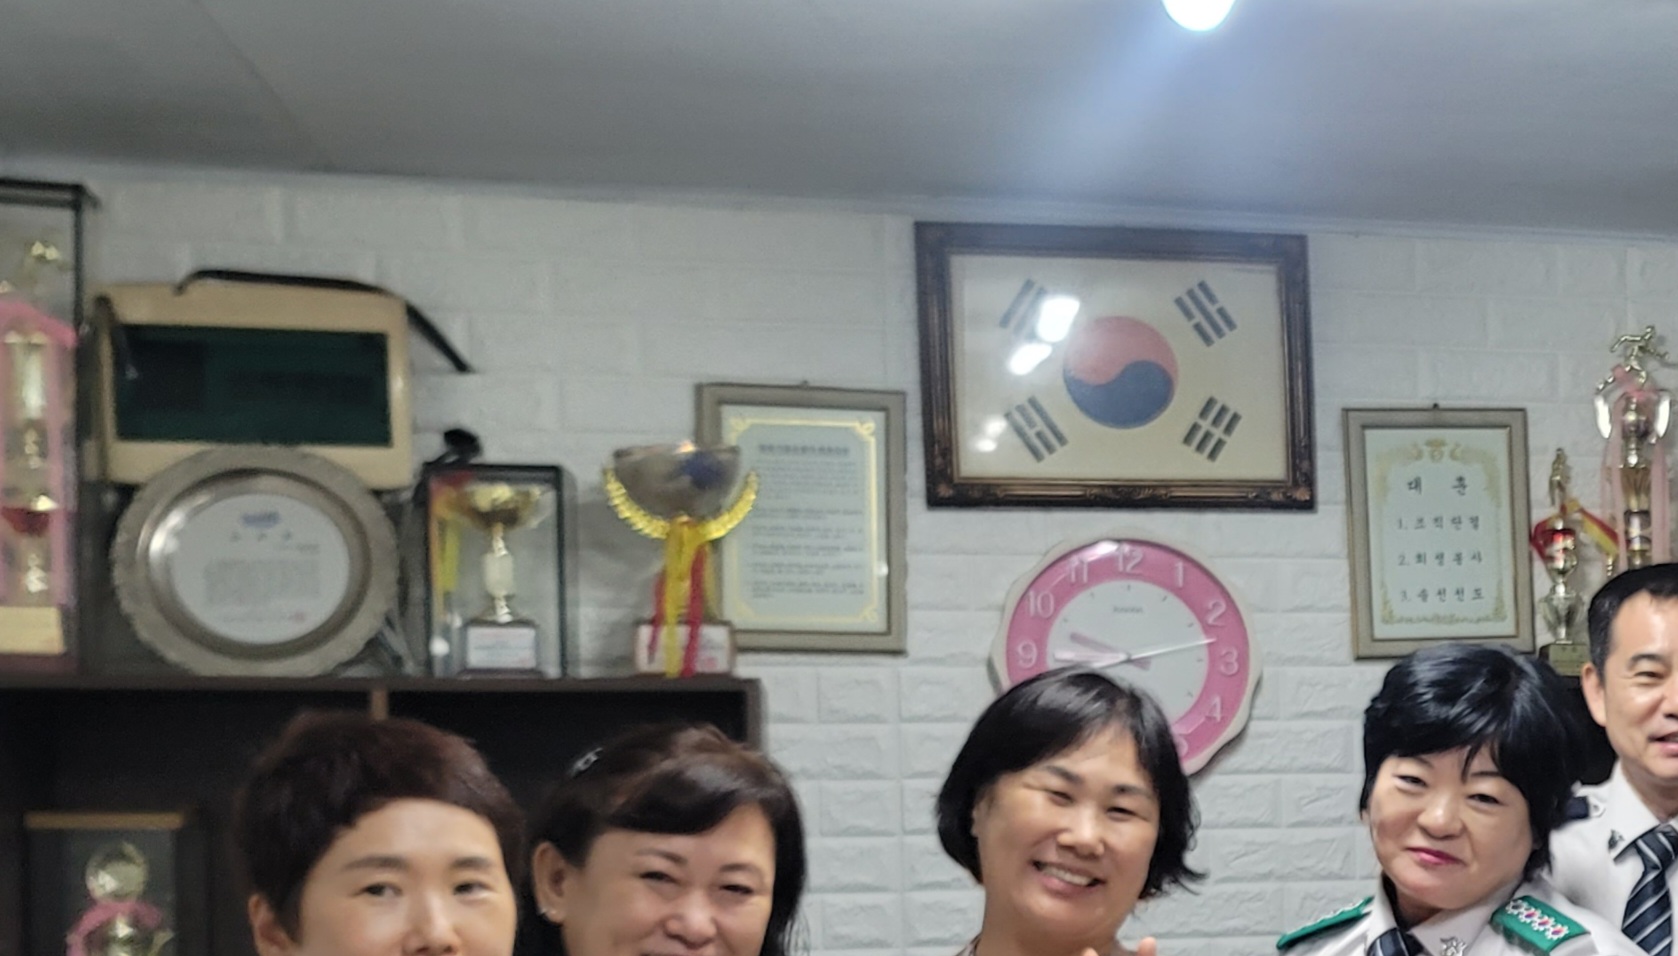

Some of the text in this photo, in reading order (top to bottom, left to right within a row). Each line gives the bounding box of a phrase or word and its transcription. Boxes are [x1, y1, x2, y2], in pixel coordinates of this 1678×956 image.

[1071, 560, 1089, 583] 11
[1116, 544, 1143, 573] 12
[1174, 561, 1184, 588] 1
[1028, 591, 1055, 618] 10
[1207, 601, 1227, 626] 2
[1017, 641, 1038, 668] 9
[1220, 649, 1240, 676] 3
[1206, 695, 1222, 723] 4
